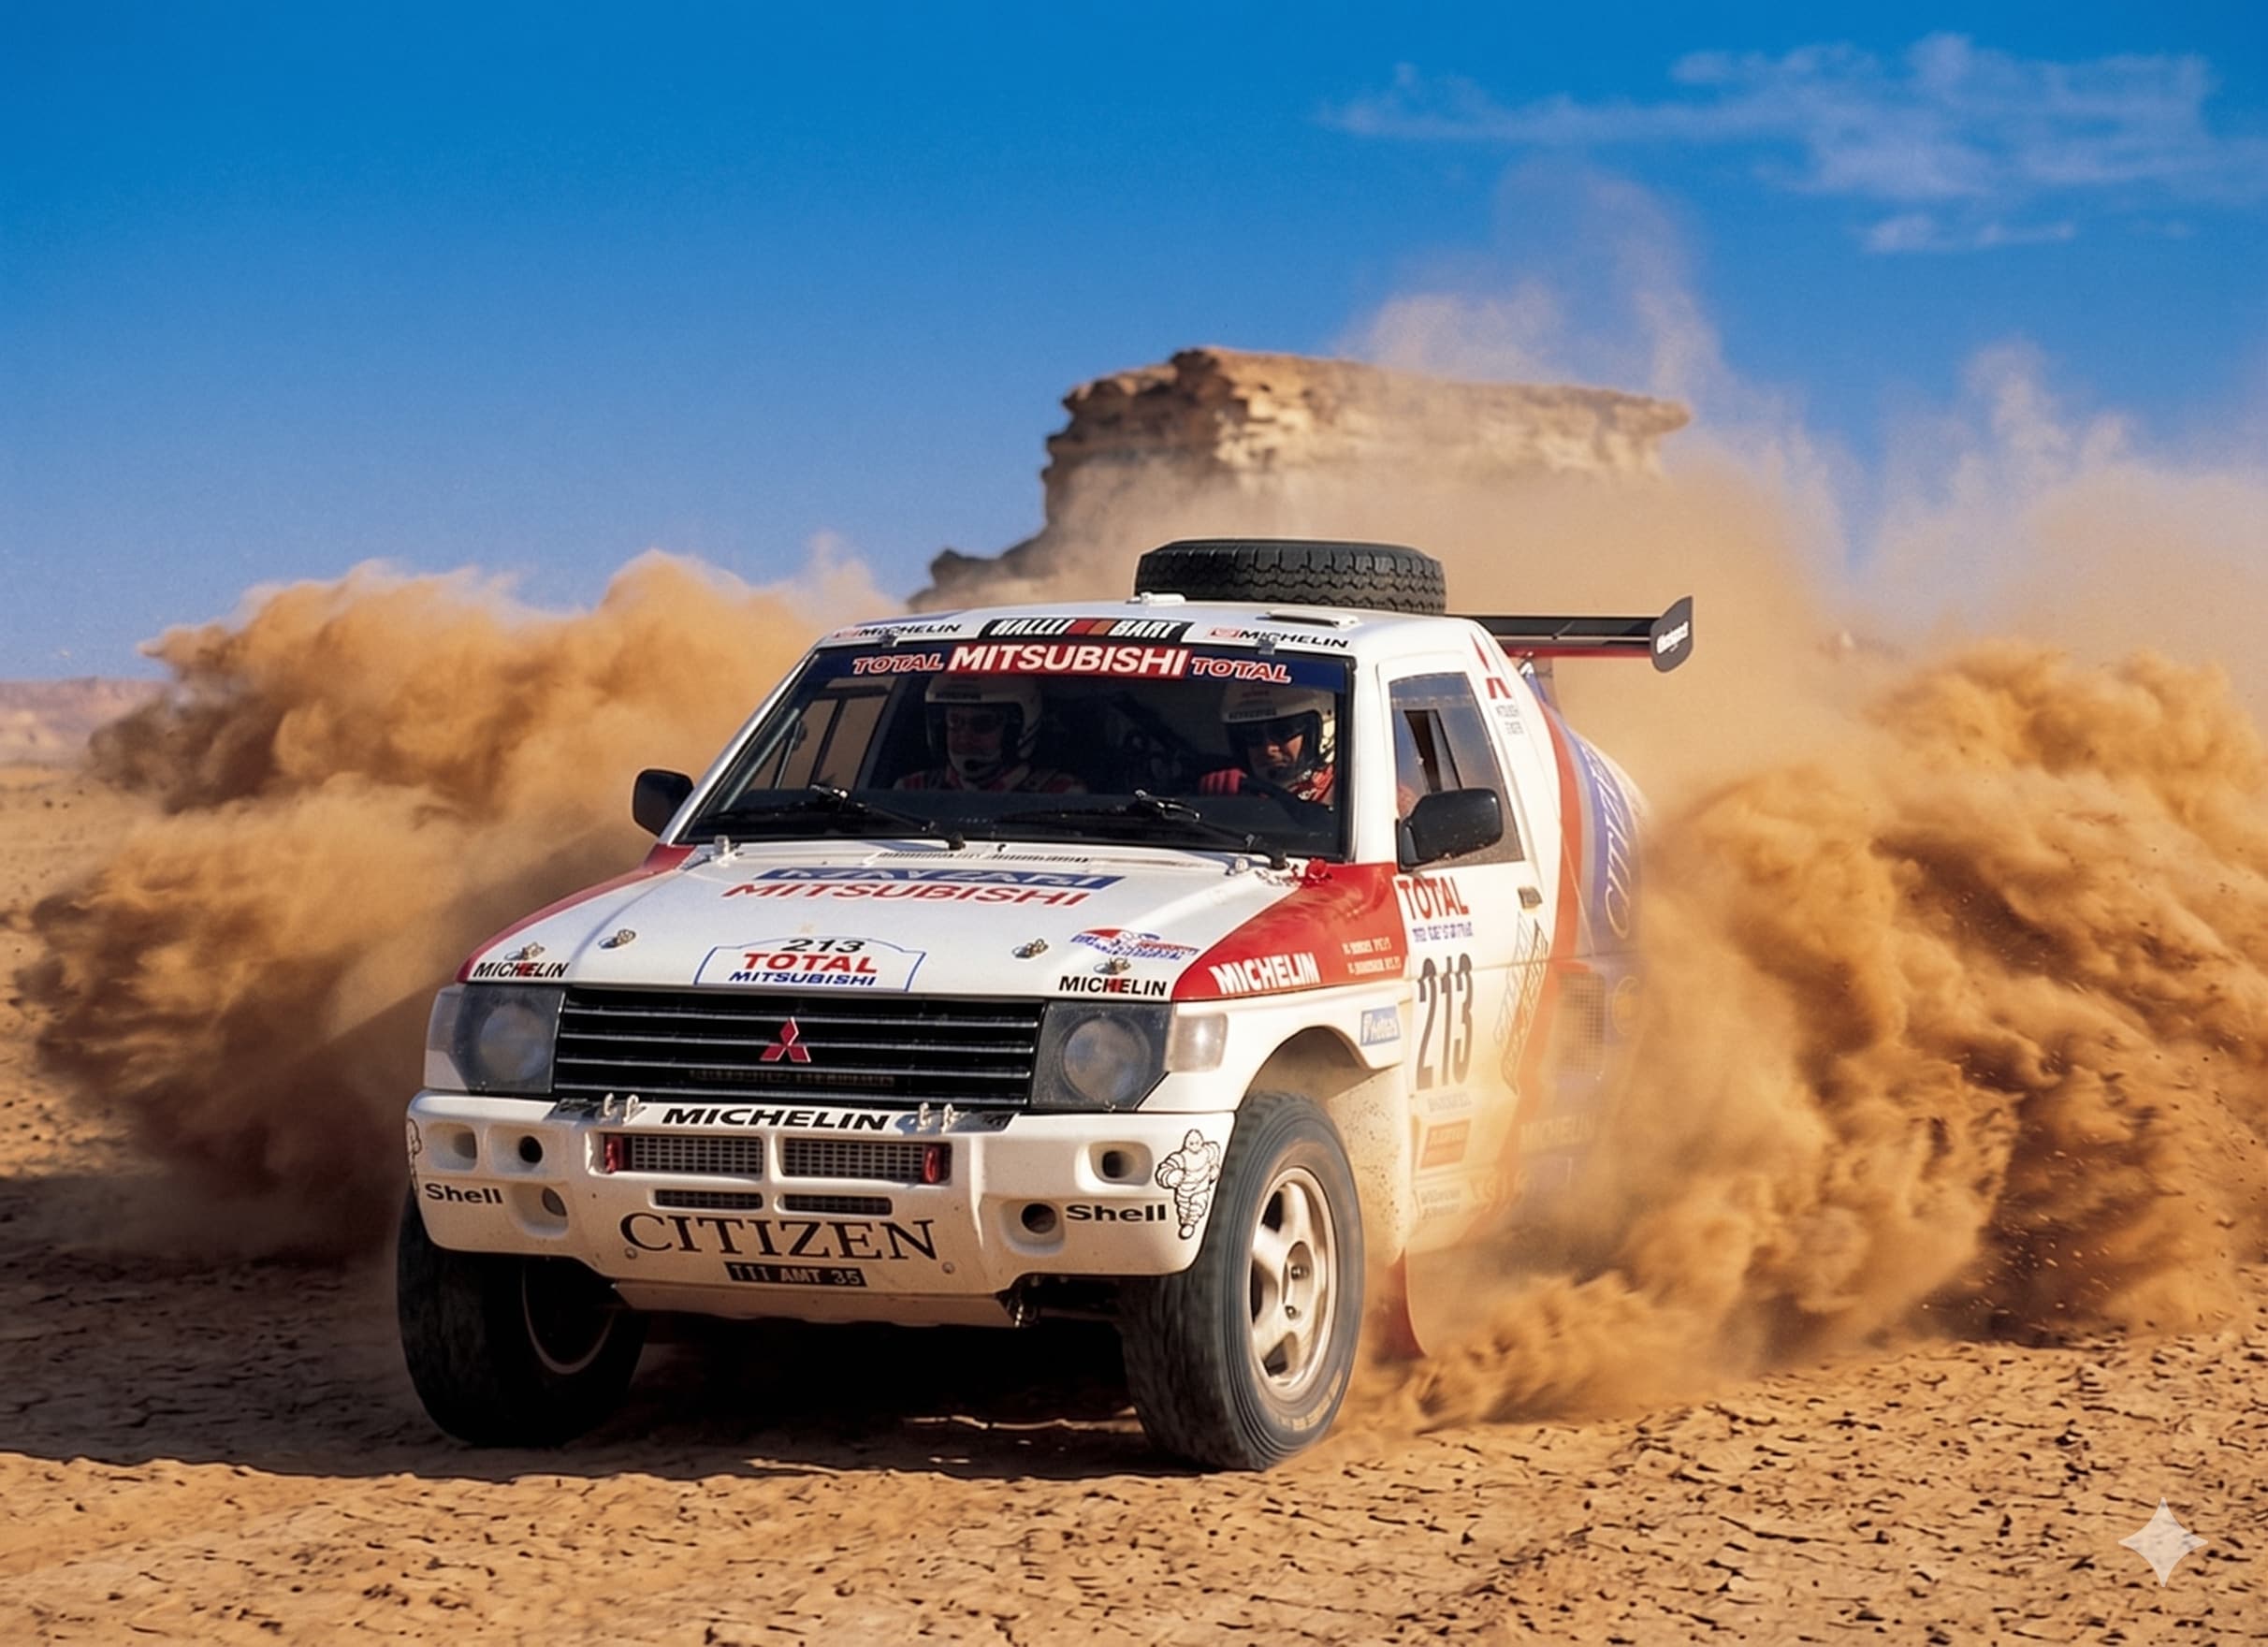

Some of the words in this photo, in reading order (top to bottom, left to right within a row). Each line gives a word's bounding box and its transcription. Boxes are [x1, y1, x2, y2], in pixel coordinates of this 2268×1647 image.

[853, 653, 944, 675] TOTAL
[947, 645, 1188, 676] MITSUBISHI
[1192, 658, 1291, 683] TOTAL
[722, 883, 1091, 906] MITSUBISHI
[1397, 876, 1470, 920] TOTAL
[780, 939, 865, 953] 213
[472, 962, 570, 978] MICHELIN
[744, 954, 878, 973] TOTAL
[1209, 952, 1321, 996] MICHELIN
[729, 971, 876, 985] MITSUBISHI
[1058, 976, 1168, 997] MICHELIN
[1416, 953, 1473, 1091] 213
[662, 1108, 889, 1130] MICHELIN
[425, 1183, 504, 1204] Shell
[1066, 1204, 1167, 1221] Shell
[619, 1213, 938, 1261] CITIZEN
[779, 1267, 821, 1283] AMT
[831, 1270, 861, 1285] 35
